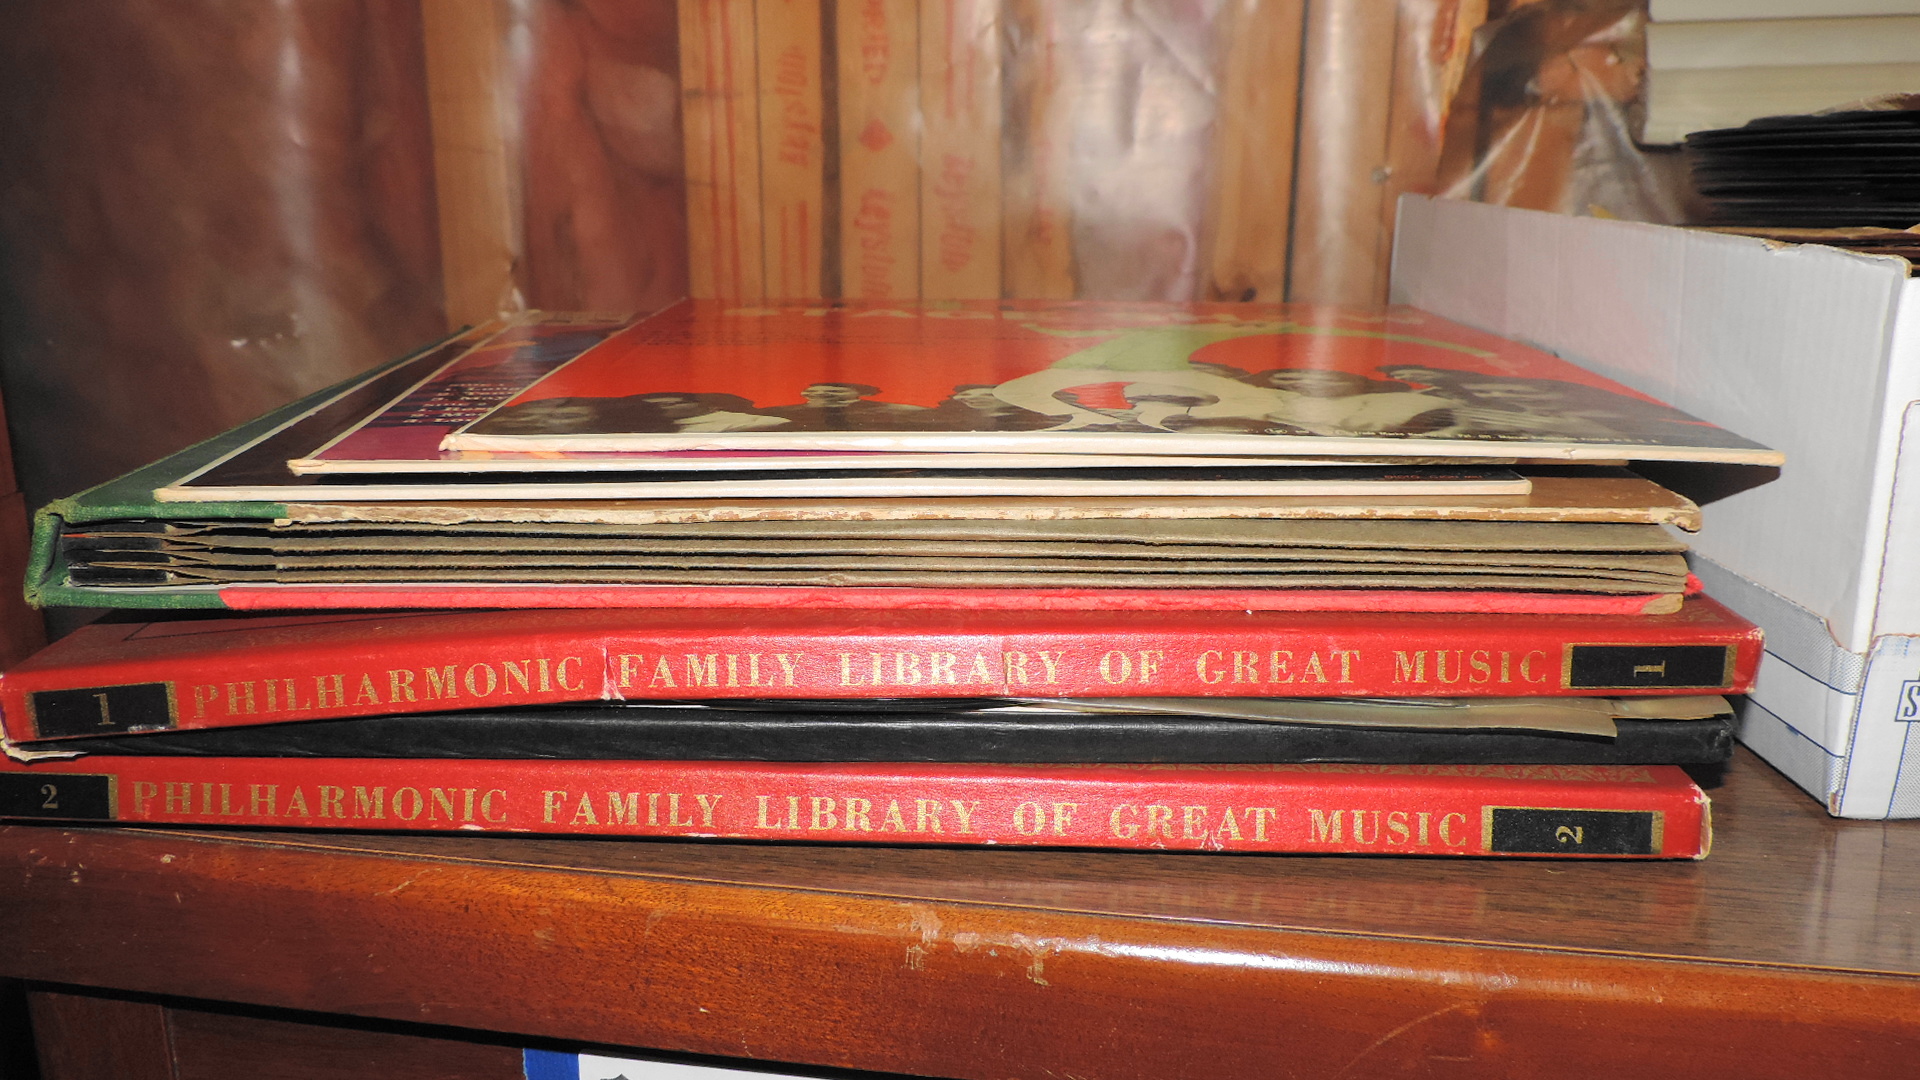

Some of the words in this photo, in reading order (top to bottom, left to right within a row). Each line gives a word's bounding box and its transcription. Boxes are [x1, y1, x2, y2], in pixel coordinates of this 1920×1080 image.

[1633, 659, 1667, 678] 1
[191, 656, 586, 720] PHILHARMONIC
[618, 651, 804, 689] FAMILY
[839, 651, 1067, 687] LIBRARY
[1099, 650, 1166, 685] OF
[1195, 650, 1363, 685] GREAT
[1392, 650, 1548, 685] MUSIC
[92, 692, 116, 726] 1
[40, 783, 59, 809] 2
[131, 780, 509, 825] PHILHARMONIC
[540, 790, 724, 829] FAMILY
[754, 795, 980, 836] LIBRARY
[1011, 801, 1080, 838] OF
[1108, 803, 1278, 845] GREAT
[1309, 807, 1469, 848] MUSIC
[1554, 825, 1584, 844] 2
